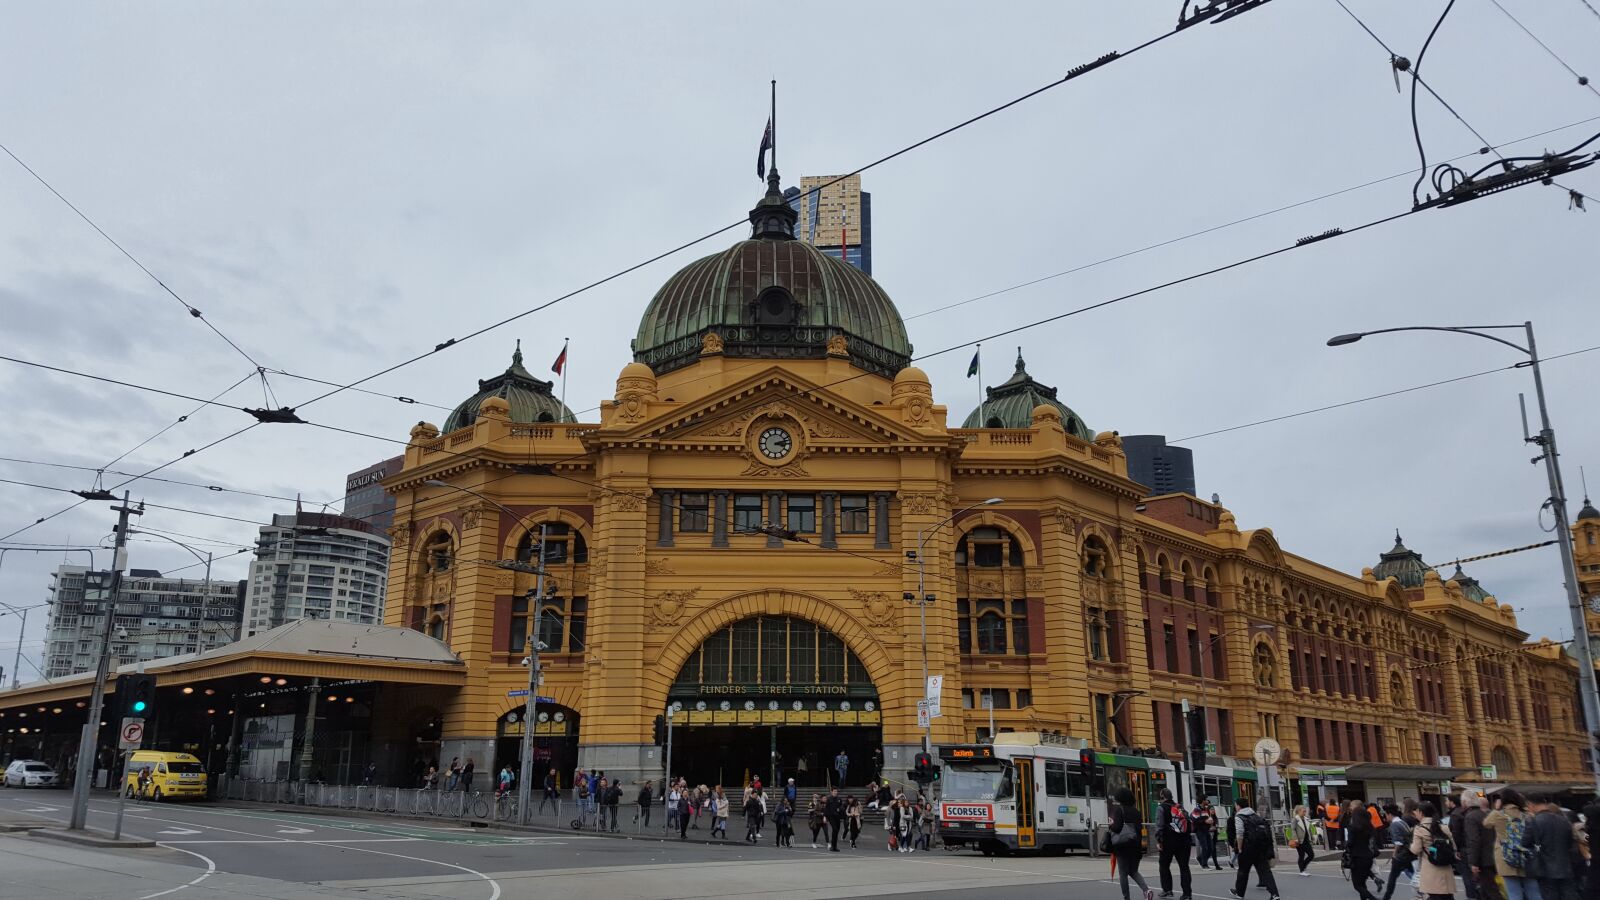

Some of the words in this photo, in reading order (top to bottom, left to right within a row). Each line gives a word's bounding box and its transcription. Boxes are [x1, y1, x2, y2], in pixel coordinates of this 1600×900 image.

[347, 475, 370, 490] HERALD
[371, 469, 386, 482] SUN
[700, 685, 747, 694] FLINDERS
[758, 685, 793, 694] STREET
[804, 685, 847, 694] STATION
[983, 749, 990, 757] 75
[947, 807, 987, 816] SCORSESE
